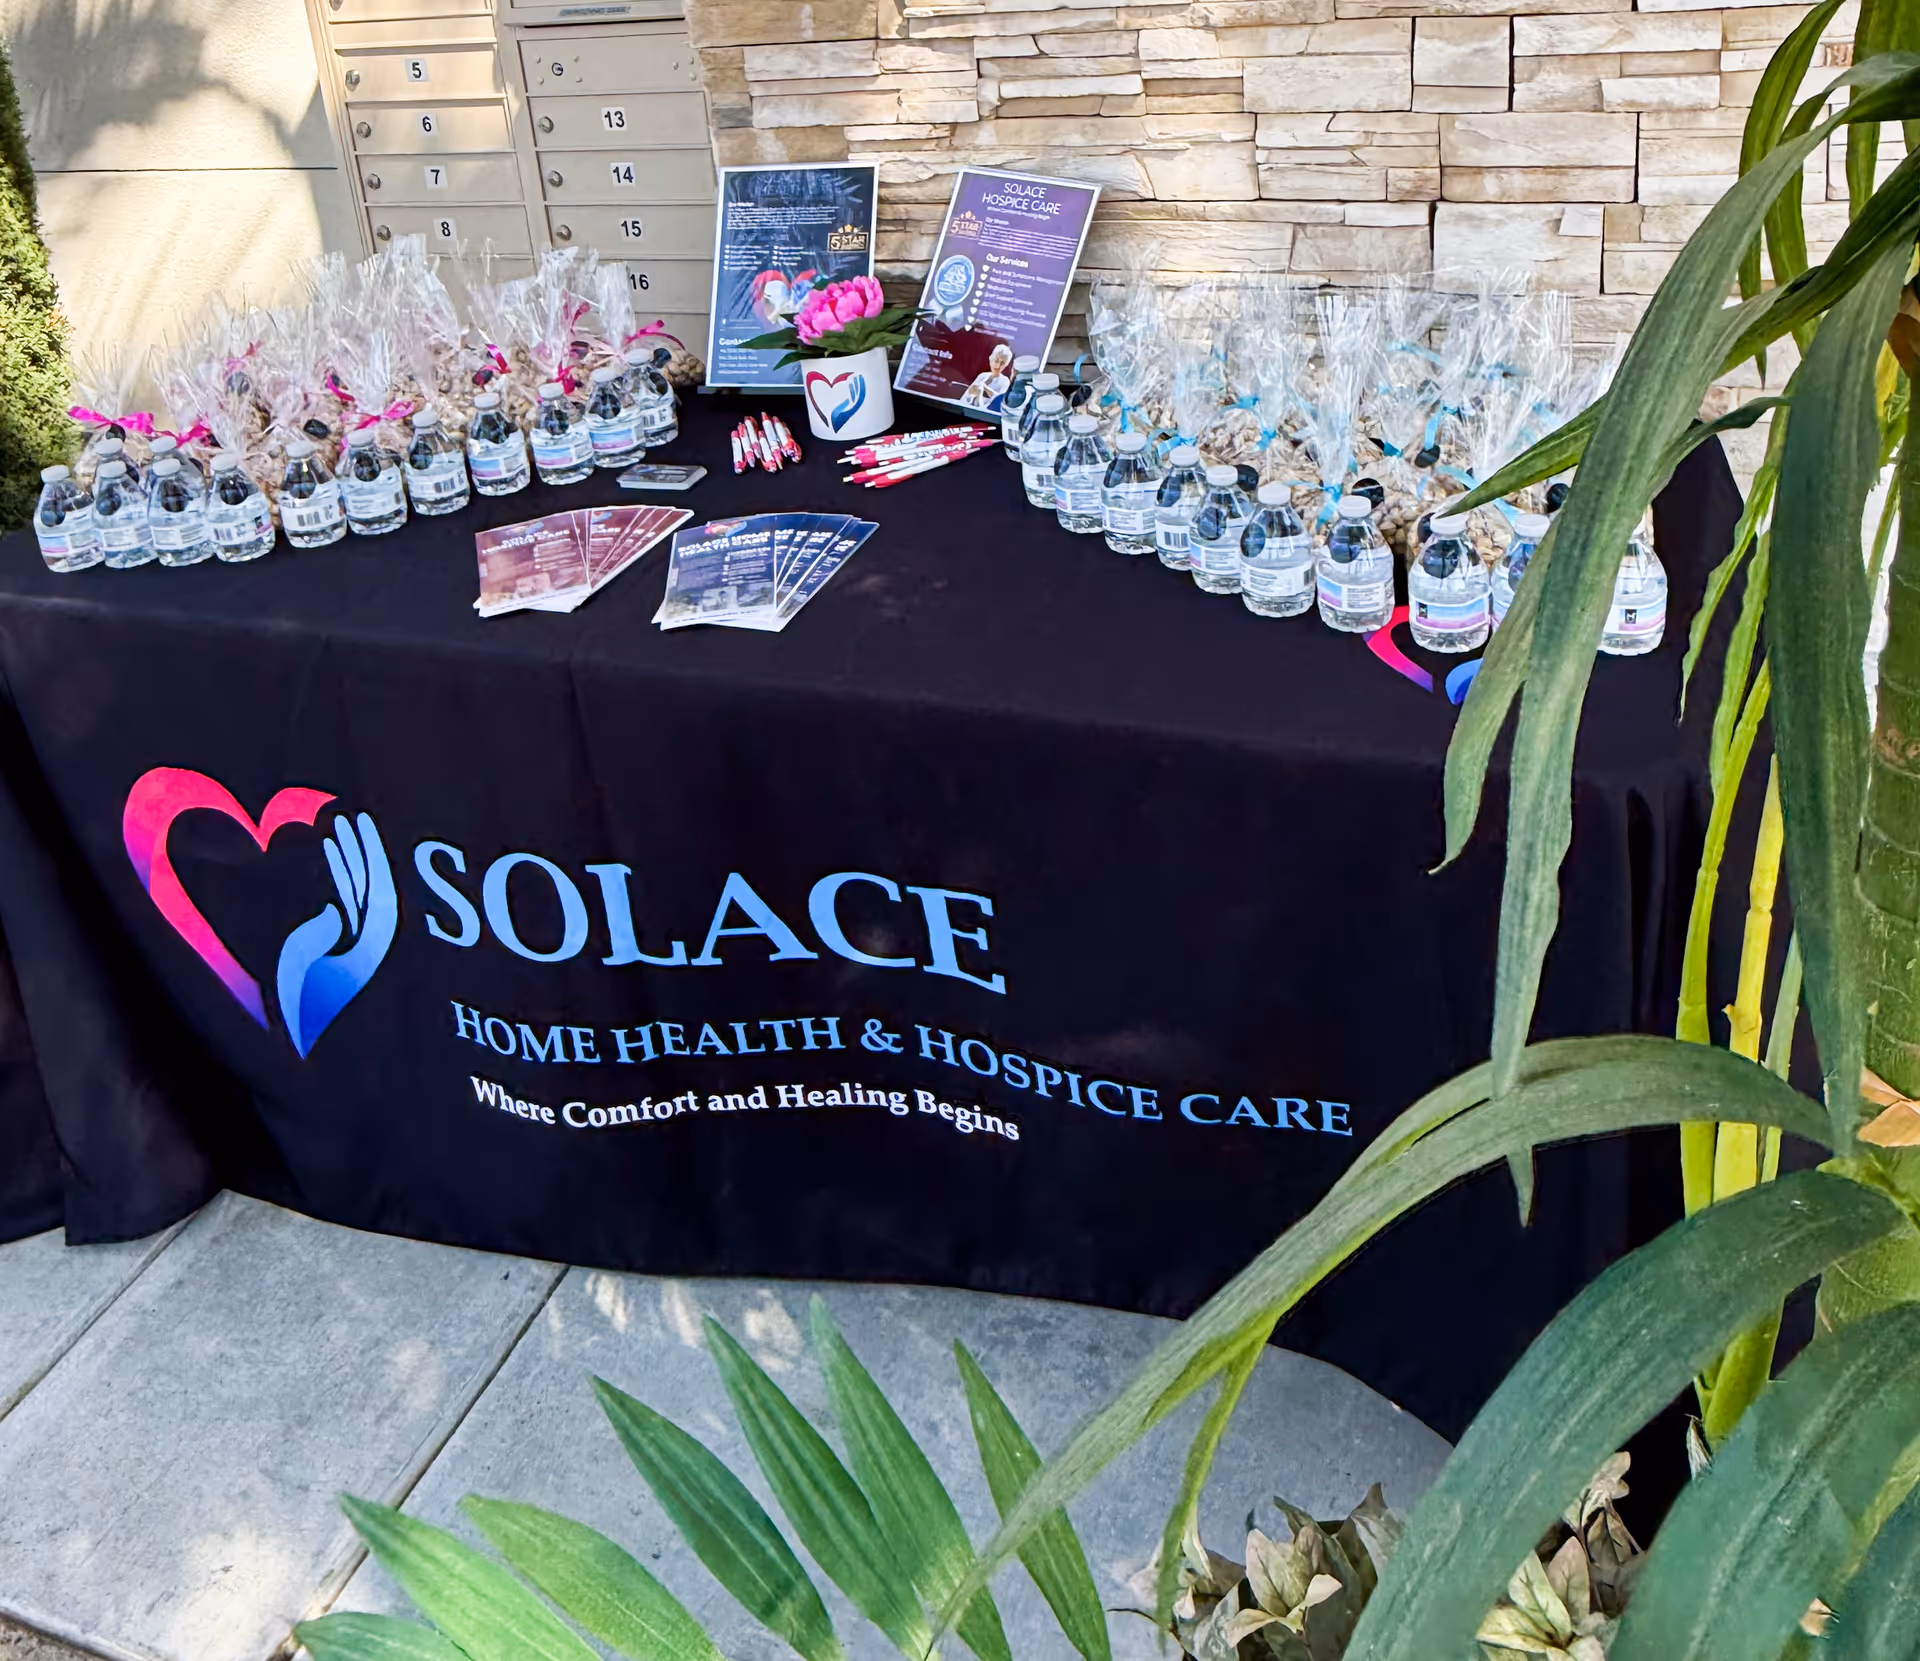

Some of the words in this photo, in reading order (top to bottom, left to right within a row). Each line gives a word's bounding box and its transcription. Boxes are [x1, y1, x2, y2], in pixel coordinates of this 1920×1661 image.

[412, 62, 422, 78] 5
[422, 117, 432, 132] 6
[604, 111, 625, 128] 13
[430, 170, 440, 184] 7
[612, 166, 633, 183] 14
[1003, 182, 1047, 199] SOLACE
[981, 193, 1030, 210] HOSPICE
[1031, 200, 1062, 215] CARE
[441, 221, 451, 237] 8
[621, 220, 642, 237] 15
[951, 220, 960, 234] 5
[831, 236, 841, 250] 5
[629, 273, 650, 291] 16
[414, 841, 1006, 994] SOLACE
[451, 1001, 601, 1063] HOME
[610, 1017, 845, 1063] HEALTH
[861, 1019, 903, 1053] &
[915, 1025, 1162, 1120] HOSPICE
[1180, 1094, 1352, 1136] CARE
[470, 1076, 555, 1124] Where
[562, 1091, 699, 1128] Comfort
[708, 1086, 769, 1111] and
[775, 1083, 909, 1115] Healing
[914, 1089, 1019, 1140] Begins
